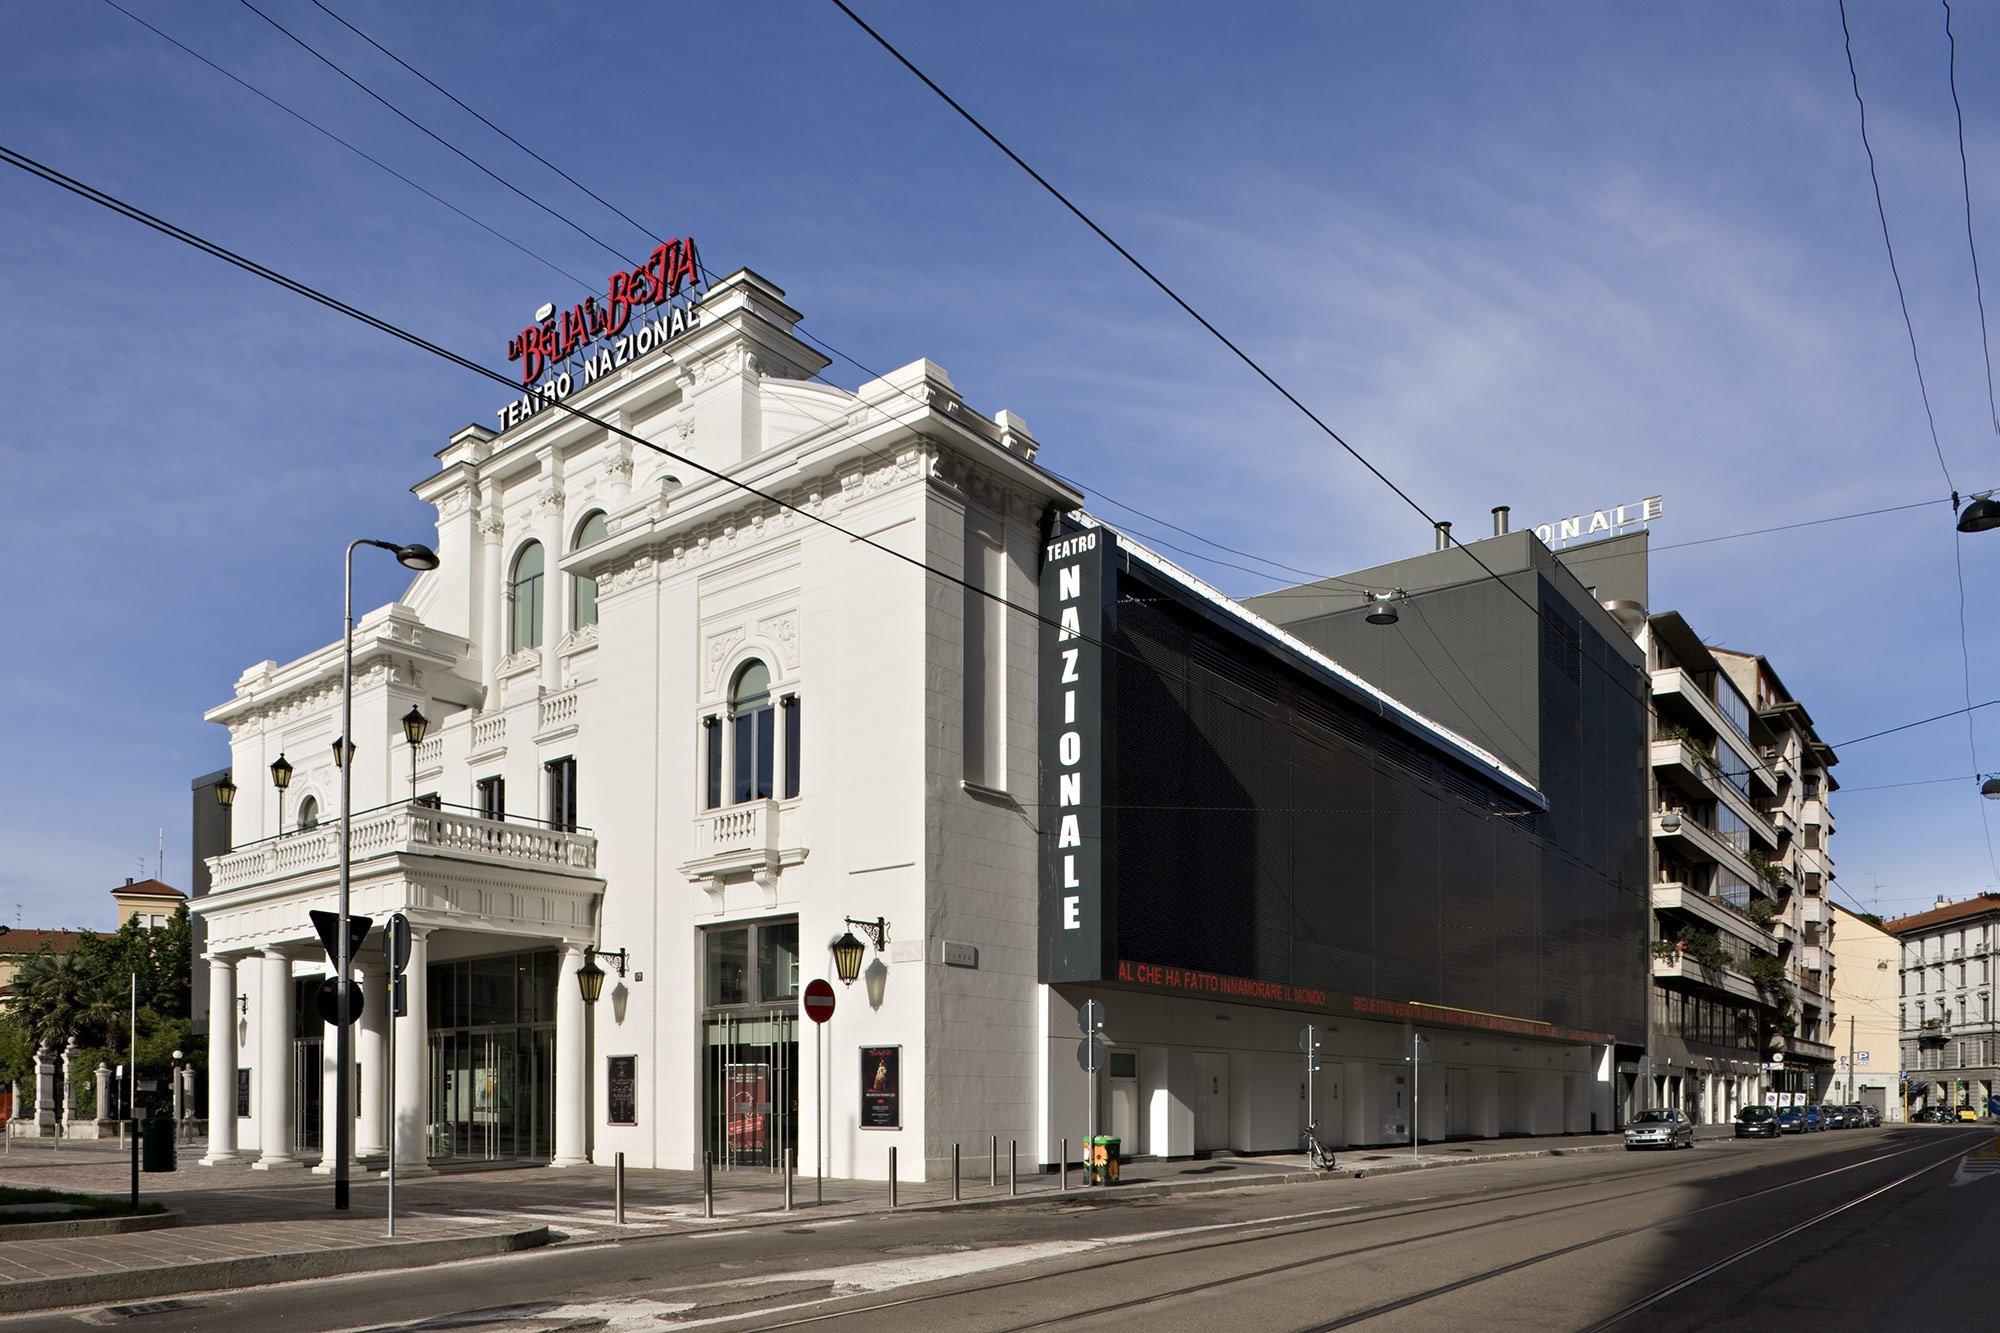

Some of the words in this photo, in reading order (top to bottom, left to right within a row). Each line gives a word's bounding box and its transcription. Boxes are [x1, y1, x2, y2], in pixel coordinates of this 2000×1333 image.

[520, 304, 590, 387] BELLA
[604, 237, 700, 341] BESTIA
[497, 372, 572, 431] TEATRO
[1046, 532, 1096, 562] TEATRO
[1058, 564, 1082, 930] NAZIONALE
[1118, 962, 1134, 982] AL
[1137, 964, 1162, 985] CHE
[1165, 968, 1181, 987] HA
[1184, 971, 1218, 992] FATTO
[1220, 976, 1282, 1000] INNAMORARE
[1284, 985, 1293, 1001] IL
[1294, 987, 1326, 1006] MONDO
